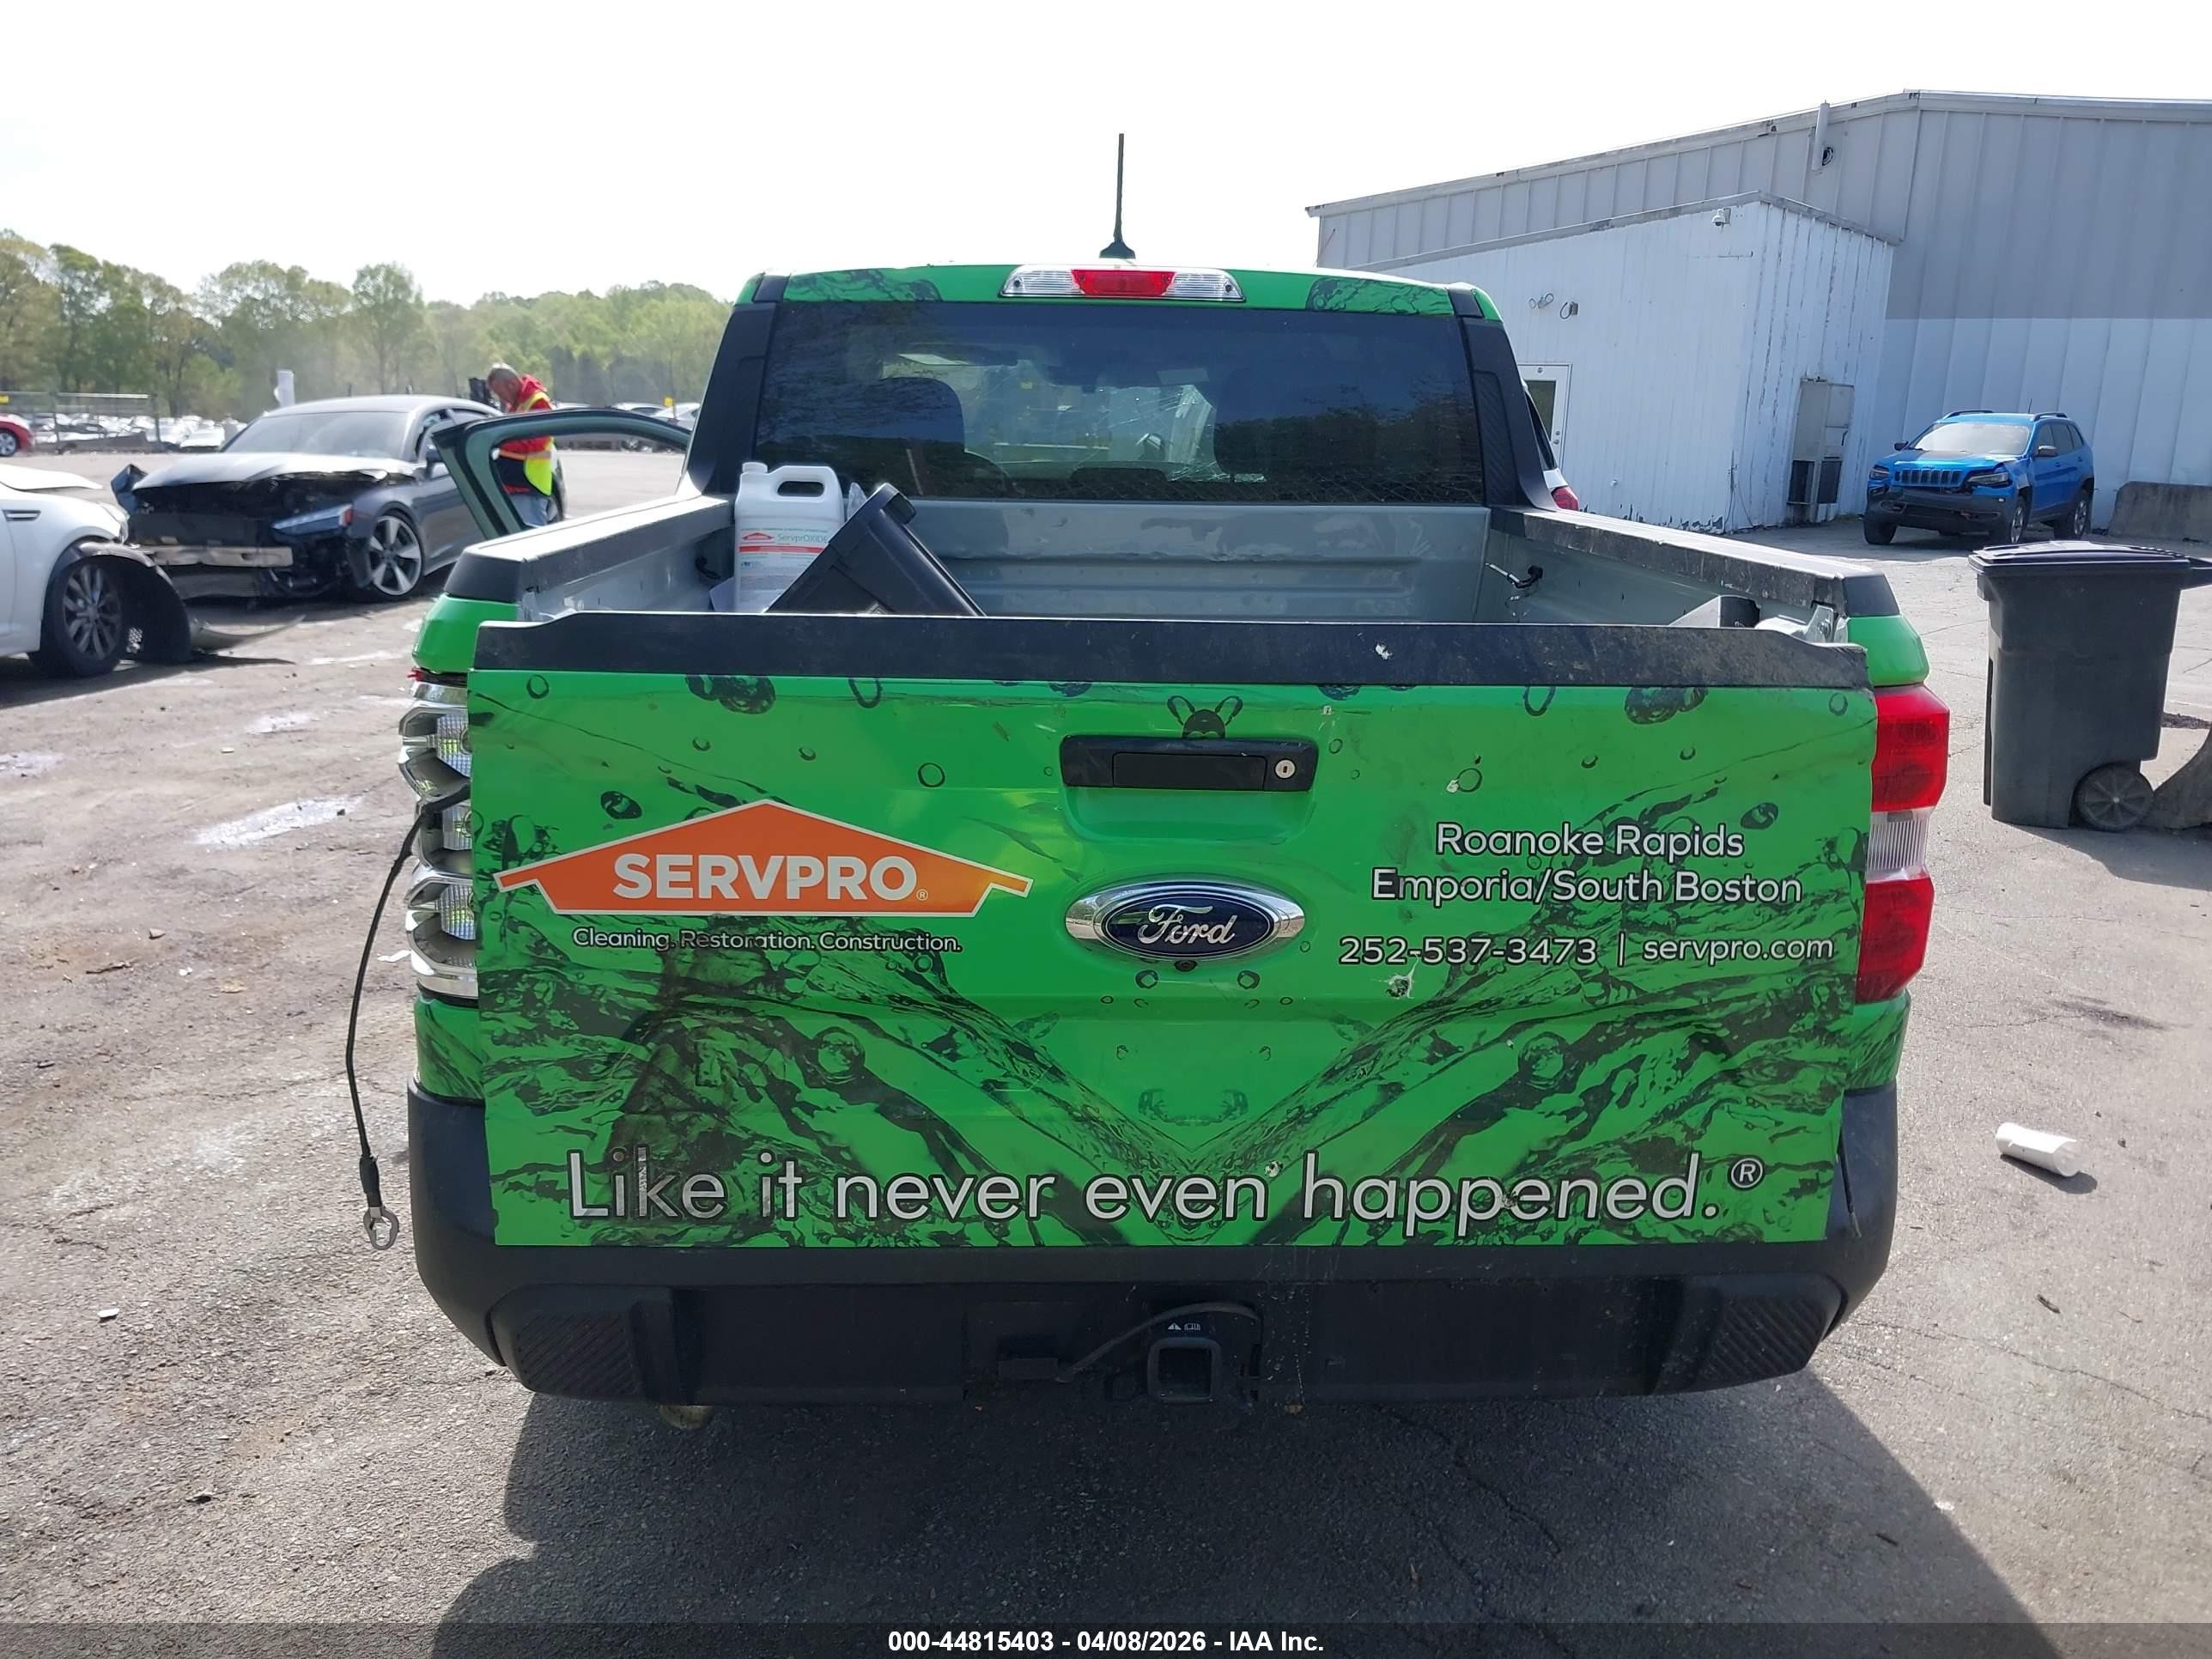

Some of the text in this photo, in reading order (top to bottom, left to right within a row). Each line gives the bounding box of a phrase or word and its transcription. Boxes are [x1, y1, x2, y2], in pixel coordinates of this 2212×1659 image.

[1437, 823, 1744, 861] Roanoke Rapids
[1372, 868, 1802, 906] Emporia/South Boston
[573, 928, 962, 952] Cleaning. Restoration. Construction.
[1138, 904, 1237, 945] Ford
[1340, 937, 1597, 965] 252-537-3473
[1643, 936, 1834, 966] servpro.com
[569, 1146, 726, 1218] Like
[760, 1152, 802, 1219] it
[836, 1174, 1055, 1220] never
[1085, 1174, 1268, 1220] even
[1303, 1152, 1718, 1237] happened.
